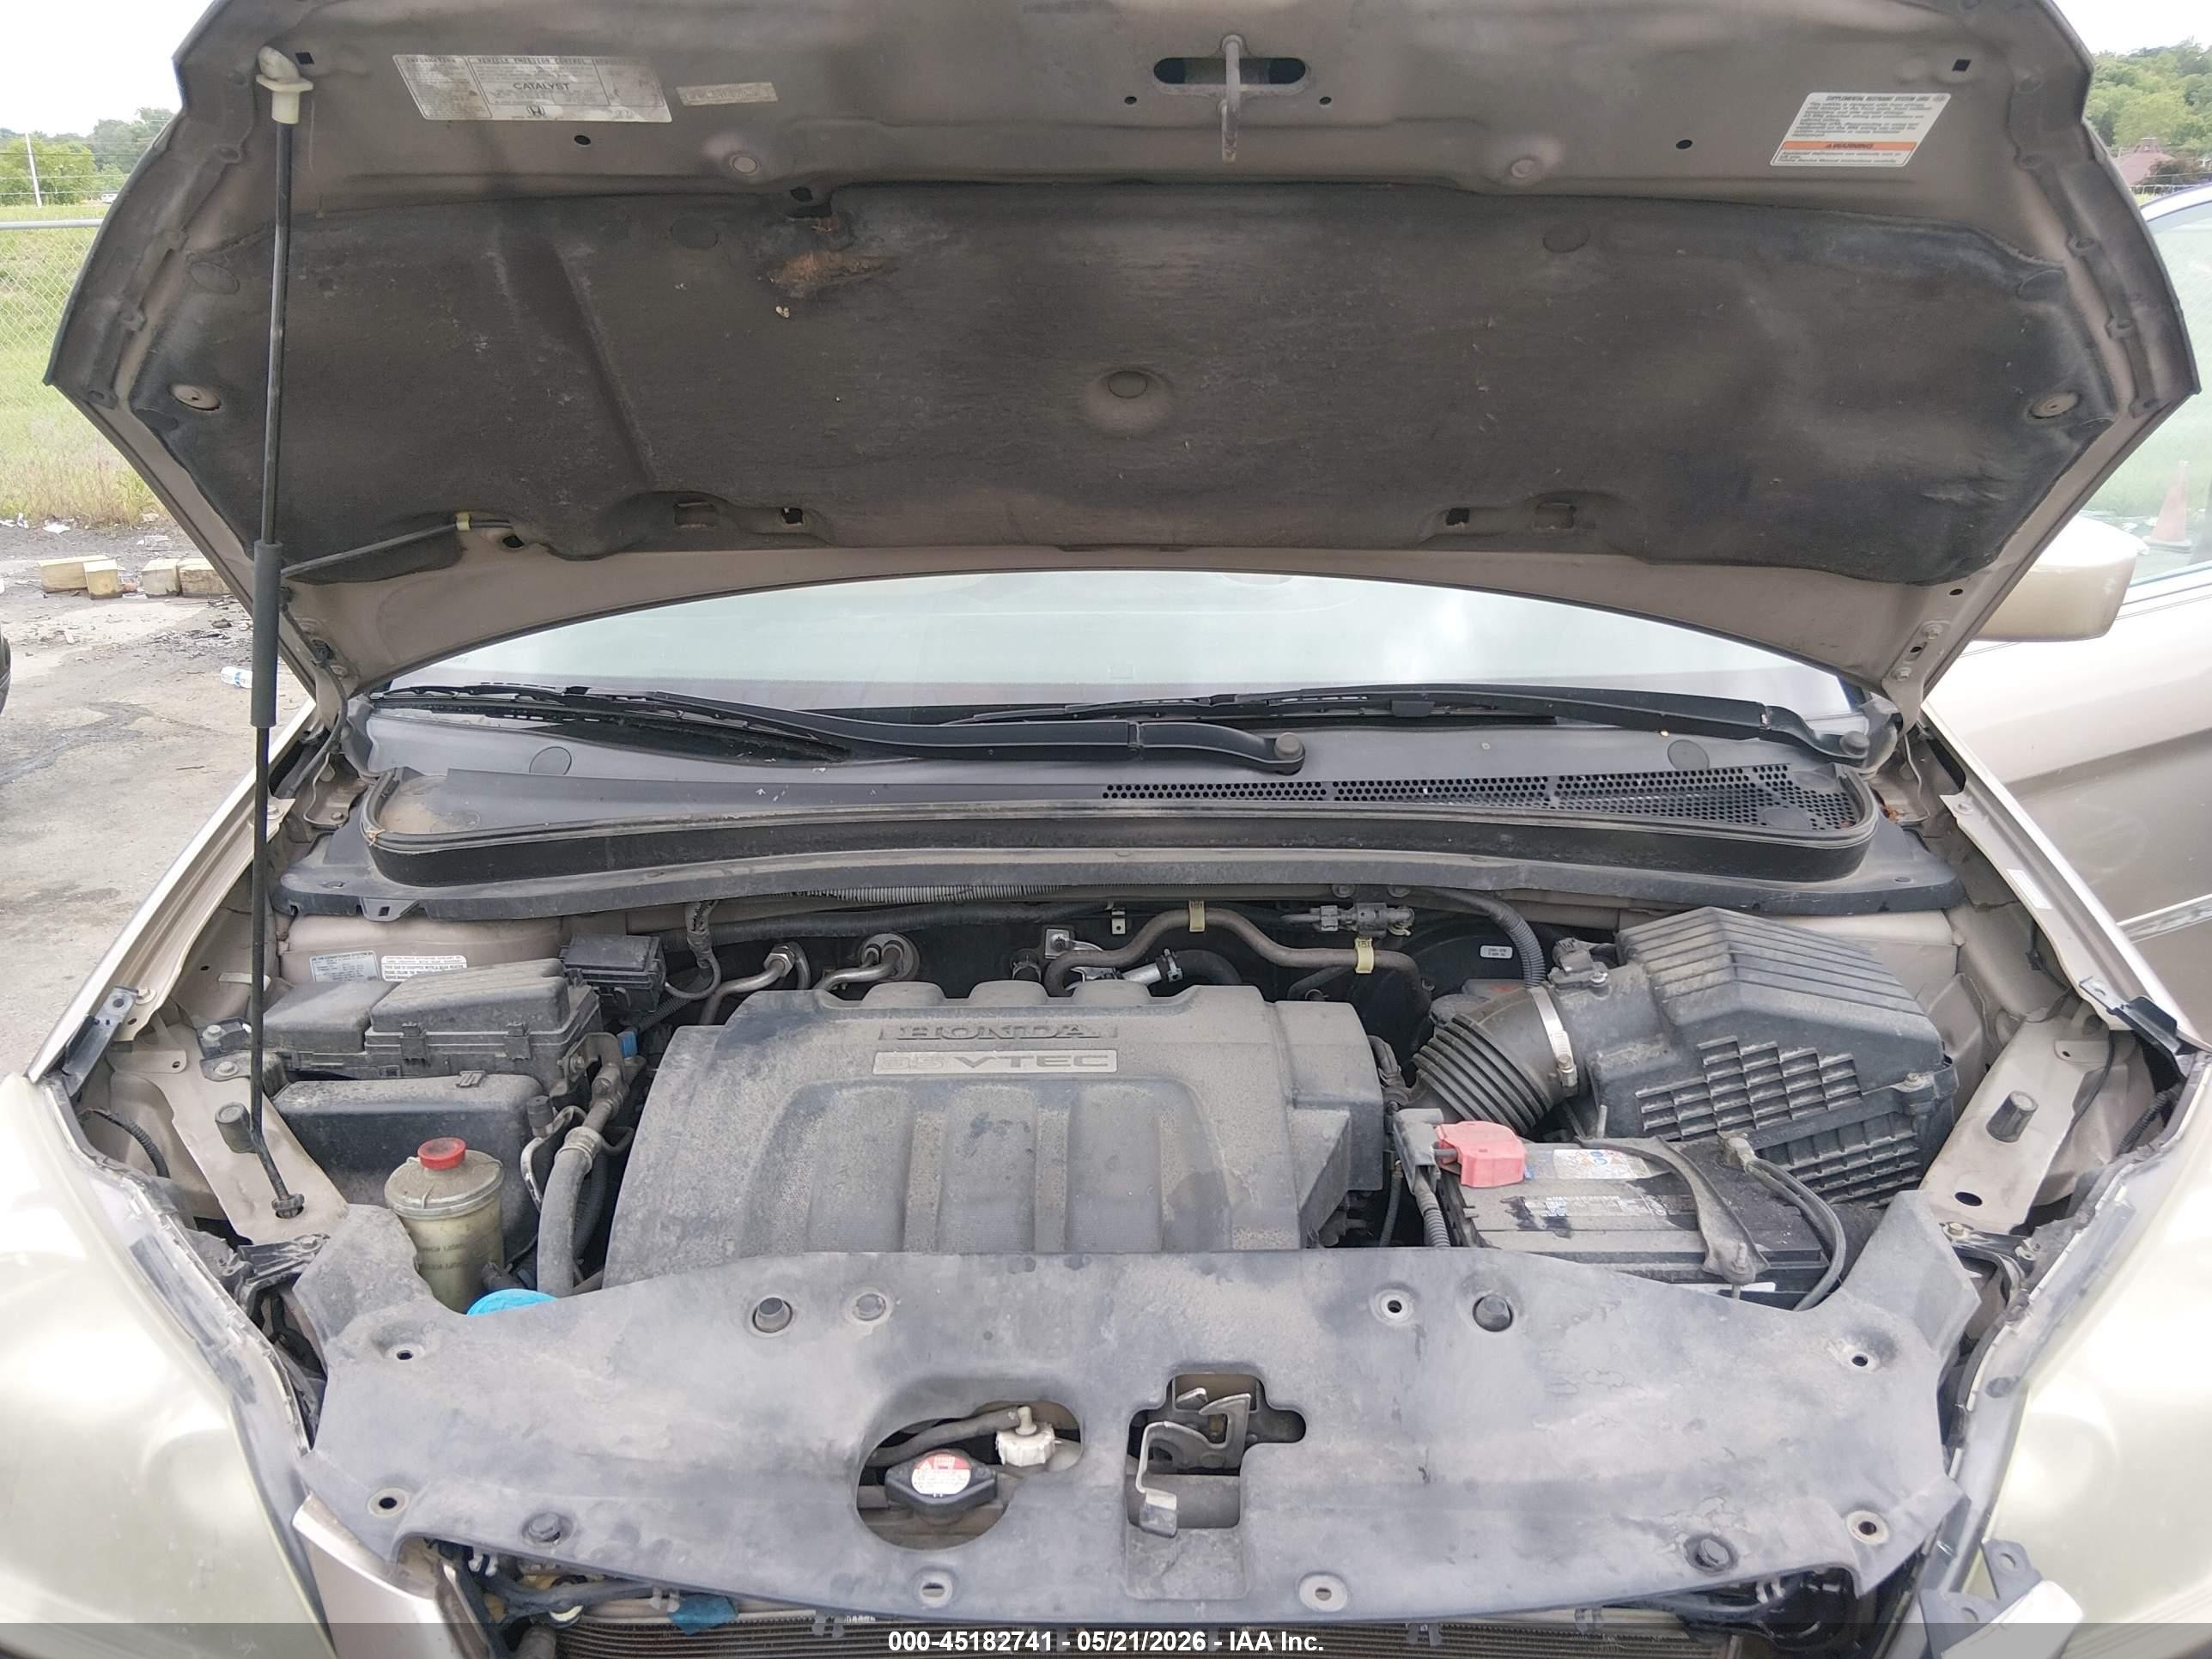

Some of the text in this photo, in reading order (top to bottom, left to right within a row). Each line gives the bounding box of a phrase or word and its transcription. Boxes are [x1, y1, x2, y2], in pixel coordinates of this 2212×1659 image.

[514, 82, 570, 90] CATALYST
[897, 1025, 1101, 1040] HONDA
[955, 1055, 1109, 1069] VTEC
